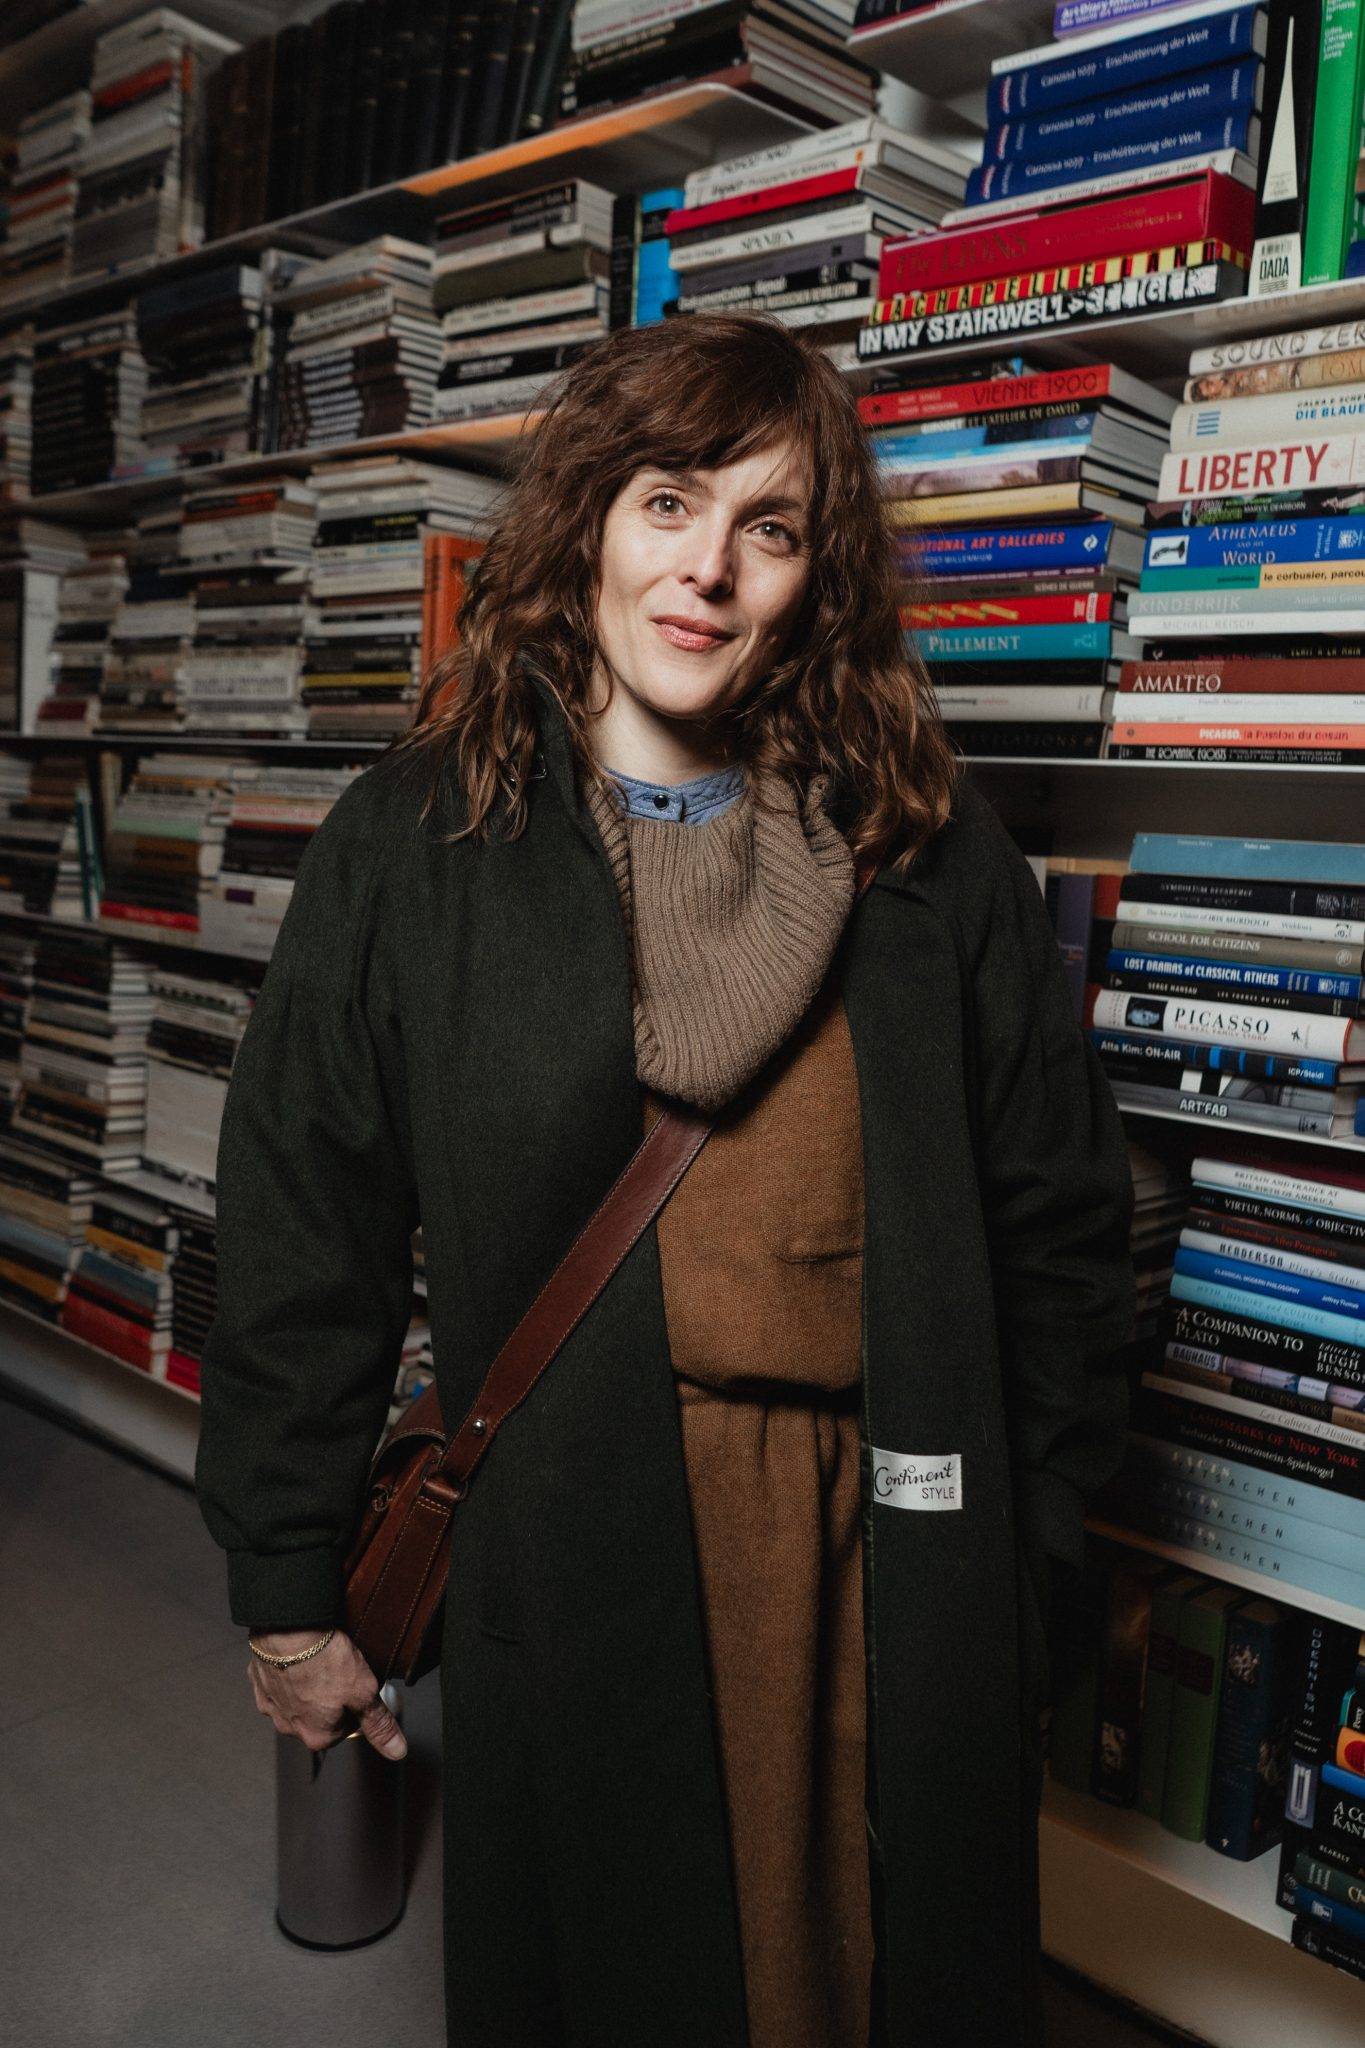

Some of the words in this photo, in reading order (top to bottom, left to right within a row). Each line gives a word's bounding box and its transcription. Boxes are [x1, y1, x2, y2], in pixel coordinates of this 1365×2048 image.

[1170, 34, 1185, 49] der
[1187, 28, 1210, 46] Welt
[1170, 88, 1186, 102] der
[1187, 83, 1210, 100] Welt
[1161, 135, 1177, 148] der
[1179, 130, 1202, 146] Welt
[1260, 256, 1289, 279] DADA
[859, 325, 883, 354] IN
[883, 318, 926, 350] MY
[926, 293, 1071, 344] STAIRWELL
[1210, 334, 1309, 368] SOUND
[972, 380, 1040, 407] VIENNE
[1045, 372, 1099, 397] 1900
[1030, 407, 1042, 420] DE
[1046, 401, 1081, 418] DAVID
[1296, 406, 1317, 421] DIE
[1322, 402, 1365, 419] BLAUE
[1178, 442, 1329, 495] LIBERTY
[970, 536, 995, 550] ART
[998, 531, 1066, 549] GALLERIES
[1208, 522, 1297, 542] ATHENAEUS
[1222, 550, 1276, 566] WORLD
[1263, 572, 1274, 582] le
[1276, 569, 1327, 581] corbusier,
[928, 635, 1021, 652] PILLEMENT
[1132, 674, 1221, 693] AMALTEO
[1226, 915, 1270, 927] MURDOCH
[1147, 931, 1188, 944] SCHOOL
[1190, 933, 1210, 946] FOR
[1212, 936, 1261, 951] CITIZENS
[1124, 957, 1145, 970] LOST
[1146, 959, 1184, 975] DRAMAS
[1185, 962, 1194, 976] of
[1196, 965, 1242, 982] CLASSICAL
[1243, 968, 1279, 986] ATHENS
[1174, 1007, 1270, 1034] PICASSO
[1174, 1023, 1188, 1031] THE
[1243, 1031, 1268, 1042] STORY
[1101, 1040, 1119, 1052] Atta
[1122, 1042, 1143, 1055] Kim:
[1145, 1046, 1181, 1061] ON-AIR
[1288, 1067, 1325, 1080] ICP/Steidl
[1234, 1171, 1270, 1185] BRITAIN
[1272, 1177, 1290, 1189] AND
[1292, 1181, 1326, 1195] FRANCE
[1224, 1199, 1264, 1216] VIRTUE,
[1264, 1207, 1302, 1225] NORMS,
[1219, 1243, 1284, 1267] HENDERSON
[1176, 1322, 1221, 1347] PLATO
[1177, 1307, 1188, 1323] A
[1193, 1311, 1281, 1347] COMPANION
[1282, 1335, 1304, 1352] TO
[1173, 1345, 1217, 1370] BAUHAUS
[1317, 1351, 1359, 1371] HUGH
[1289, 1436, 1320, 1455] NEW
[1326, 1447, 1360, 1468] YORK
[875, 1462, 953, 1497] Continent
[922, 1487, 954, 1499] STYLE
